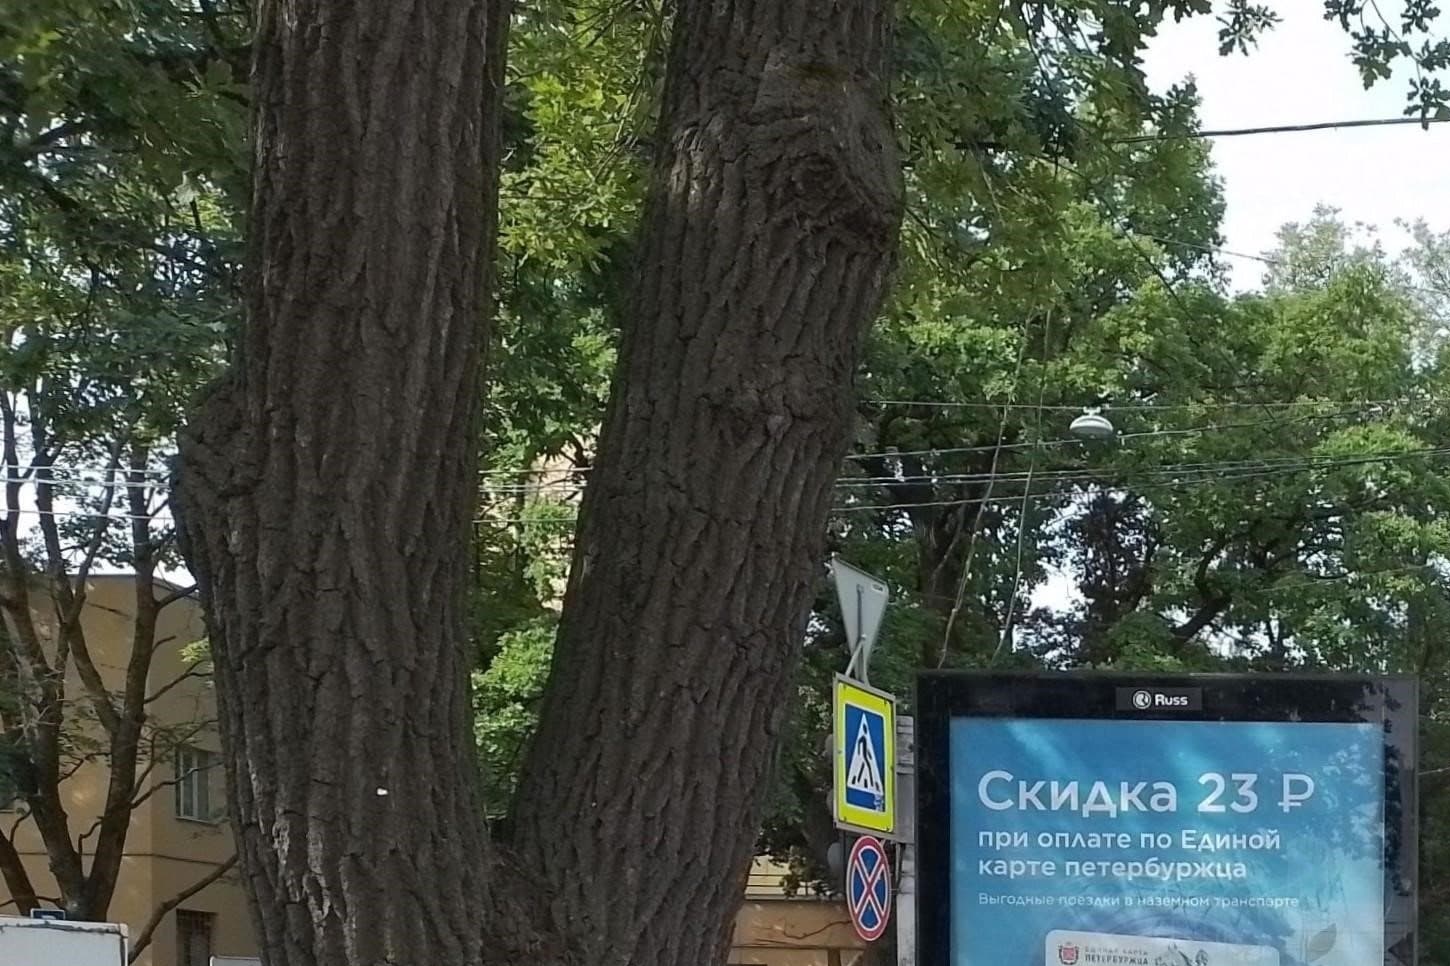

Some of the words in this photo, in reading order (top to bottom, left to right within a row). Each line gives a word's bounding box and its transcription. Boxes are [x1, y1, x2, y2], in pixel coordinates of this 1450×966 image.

[1154, 693, 1188, 706] Russ
[978, 770, 1177, 818] Скидка
[1197, 772, 1258, 813] 23
[978, 831, 1028, 850] при
[1037, 832, 1131, 849] оплате
[1140, 832, 1172, 849] по
[1181, 829, 1280, 851] Единой
[978, 859, 1056, 879] карте
[1065, 857, 1247, 881] петербуржца
[978, 892, 1054, 907] Выгодные
[1058, 894, 1120, 907] поездки
[1124, 896, 1133, 906] в
[1137, 896, 1209, 906] наземном
[1214, 896, 1299, 908] транспорте
